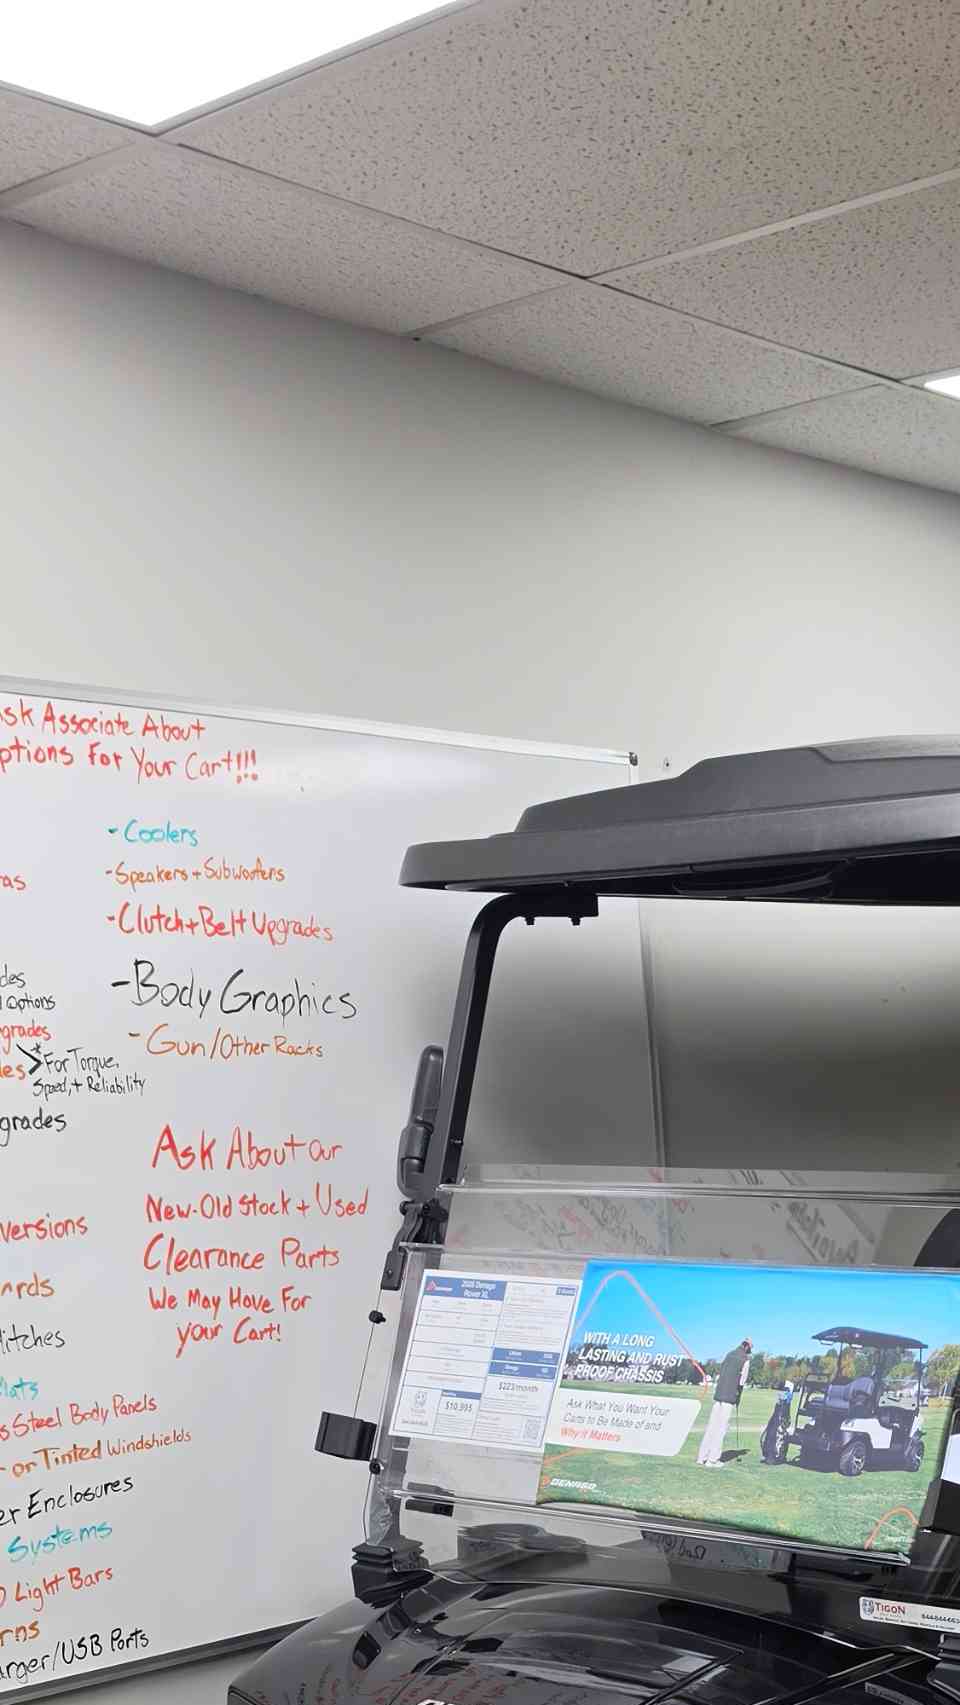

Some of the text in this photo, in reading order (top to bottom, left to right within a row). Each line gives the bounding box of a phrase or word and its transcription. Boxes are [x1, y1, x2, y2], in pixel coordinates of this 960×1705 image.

[0, 698, 34, 728] sk
[142, 714, 206, 742] About
[88, 741, 123, 771] For
[130, 745, 177, 784] Your
[219, 968, 358, 1031] Graphics
[151, 1123, 216, 1171] Ask
[225, 1125, 306, 1171] About
[315, 1181, 369, 1218] Used
[143, 1232, 340, 1276] Clearance Parts
[148, 1285, 312, 1321] We May Have For
[0, 1323, 66, 1354] itches
[578, 1347, 685, 1367] LASTING AND RUST
[583, 1331, 612, 1344] WITH
[623, 1334, 656, 1348] LONG
[574, 1364, 665, 1383] PROOF CHASSIS
[112, 1393, 158, 1417] Panels
[106, 1428, 192, 1457] Windshields
[27, 1476, 134, 1519] Enclosures
[7, 1521, 113, 1563] Systems
[15, 1575, 66, 1613] Light
[68, 1566, 113, 1590] Bars
[110, 1627, 150, 1652] Ports
